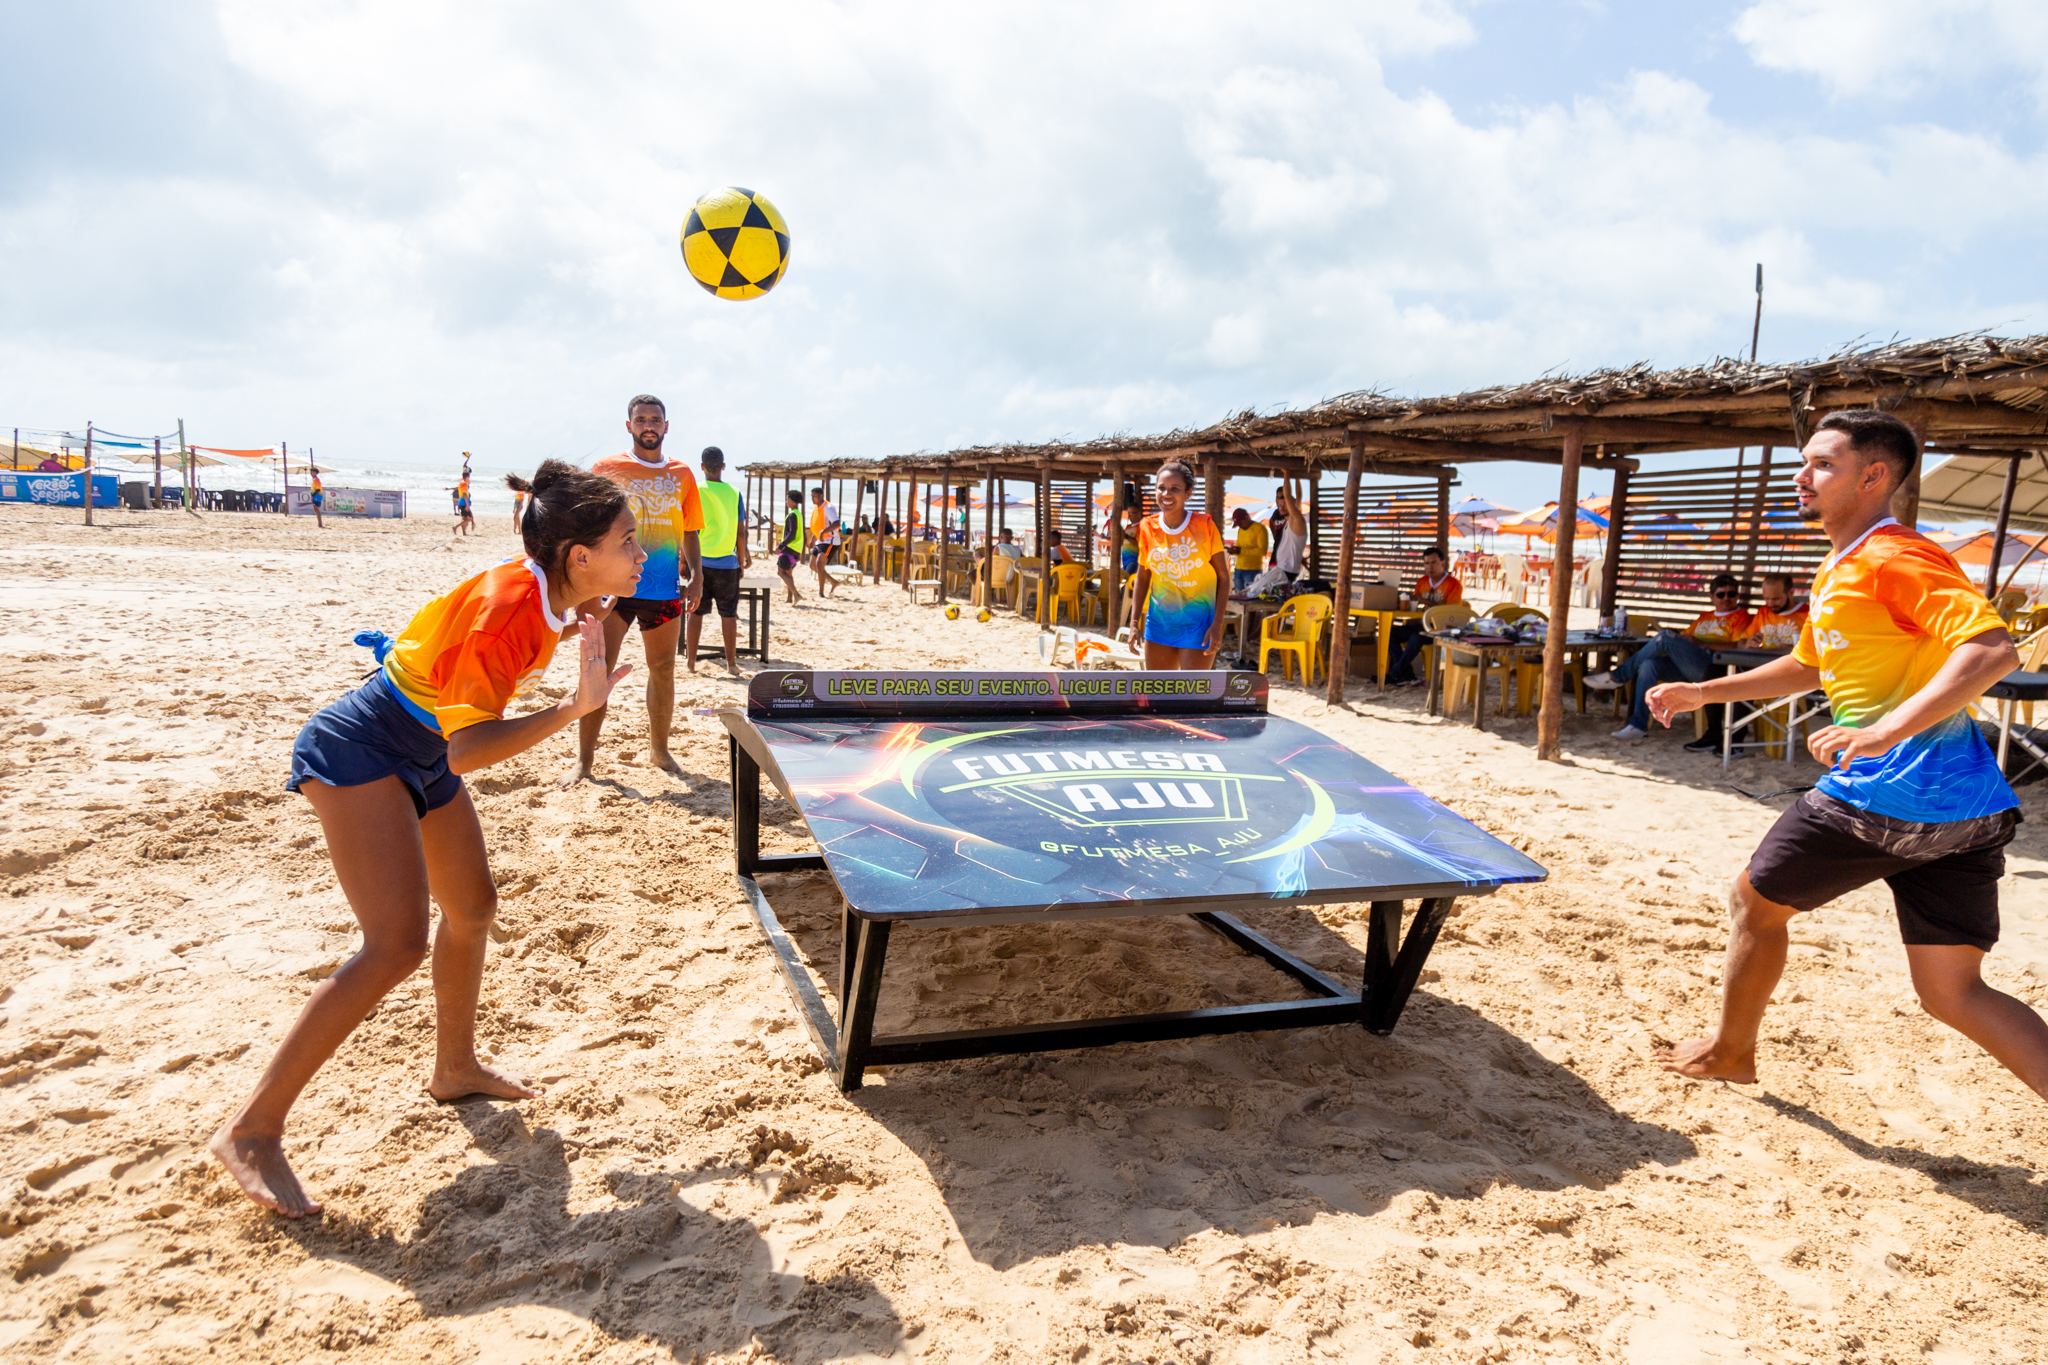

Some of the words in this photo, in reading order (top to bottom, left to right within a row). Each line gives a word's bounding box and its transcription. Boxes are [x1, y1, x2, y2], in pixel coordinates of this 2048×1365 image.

[828, 678, 877, 695] LEVE
[882, 678, 931, 695] PARA
[935, 678, 974, 695] SEU
[978, 679, 1054, 695] EVENTO.
[1058, 679, 1112, 695] LIGUE
[1115, 679, 1128, 695] E
[1130, 679, 1211, 695] RESERVE!
[952, 751, 1227, 780] FUTMESA
[1062, 781, 1215, 812] AJU
